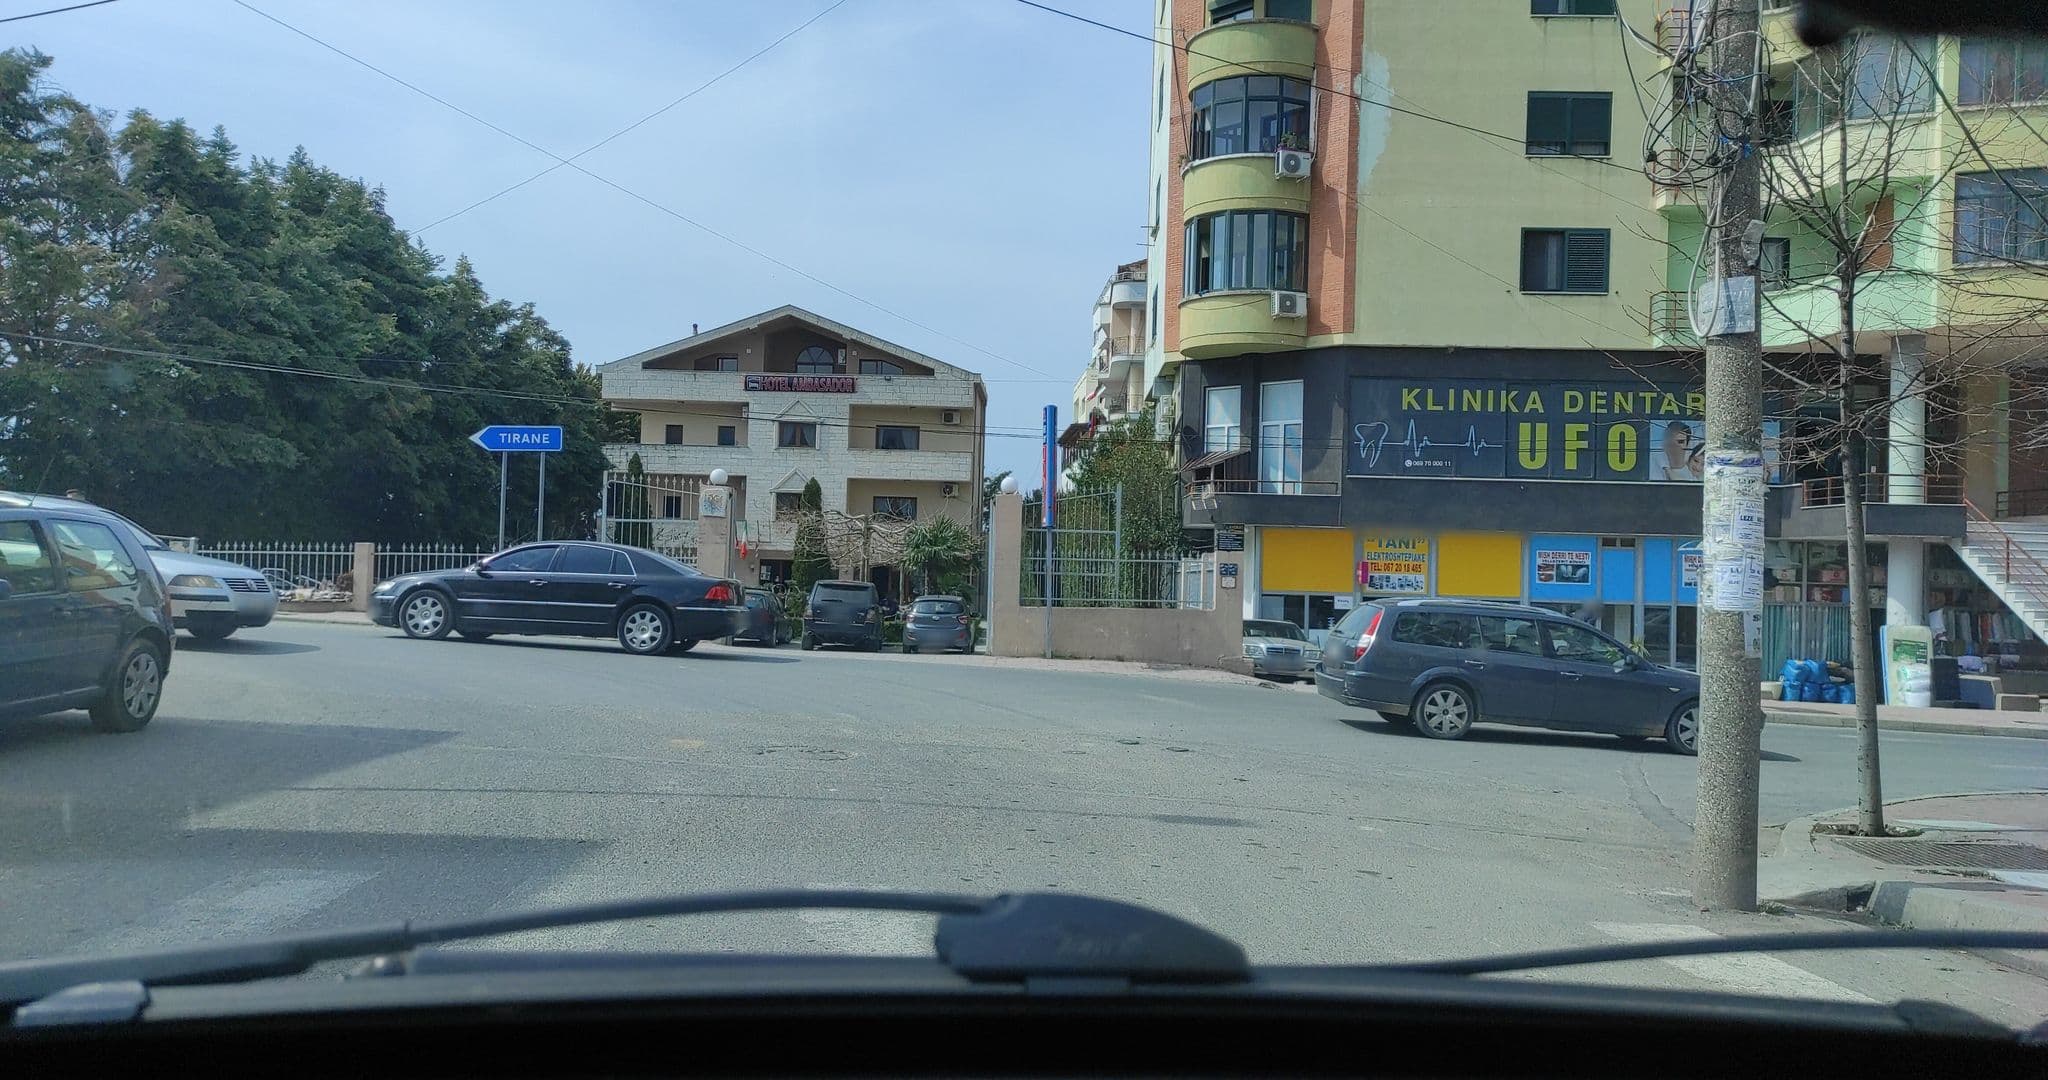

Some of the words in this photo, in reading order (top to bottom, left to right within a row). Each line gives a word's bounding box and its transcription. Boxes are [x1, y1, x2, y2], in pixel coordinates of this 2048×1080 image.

[761, 377, 790, 391] HOTEL
[792, 378, 853, 392] AMBASADOR
[1402, 388, 1545, 413] KLINIKA
[499, 433, 550, 444] TIRANE
[1518, 422, 1637, 472] UFO
[1370, 562, 1382, 572] TEL:
[1395, 562, 1403, 572] 20
